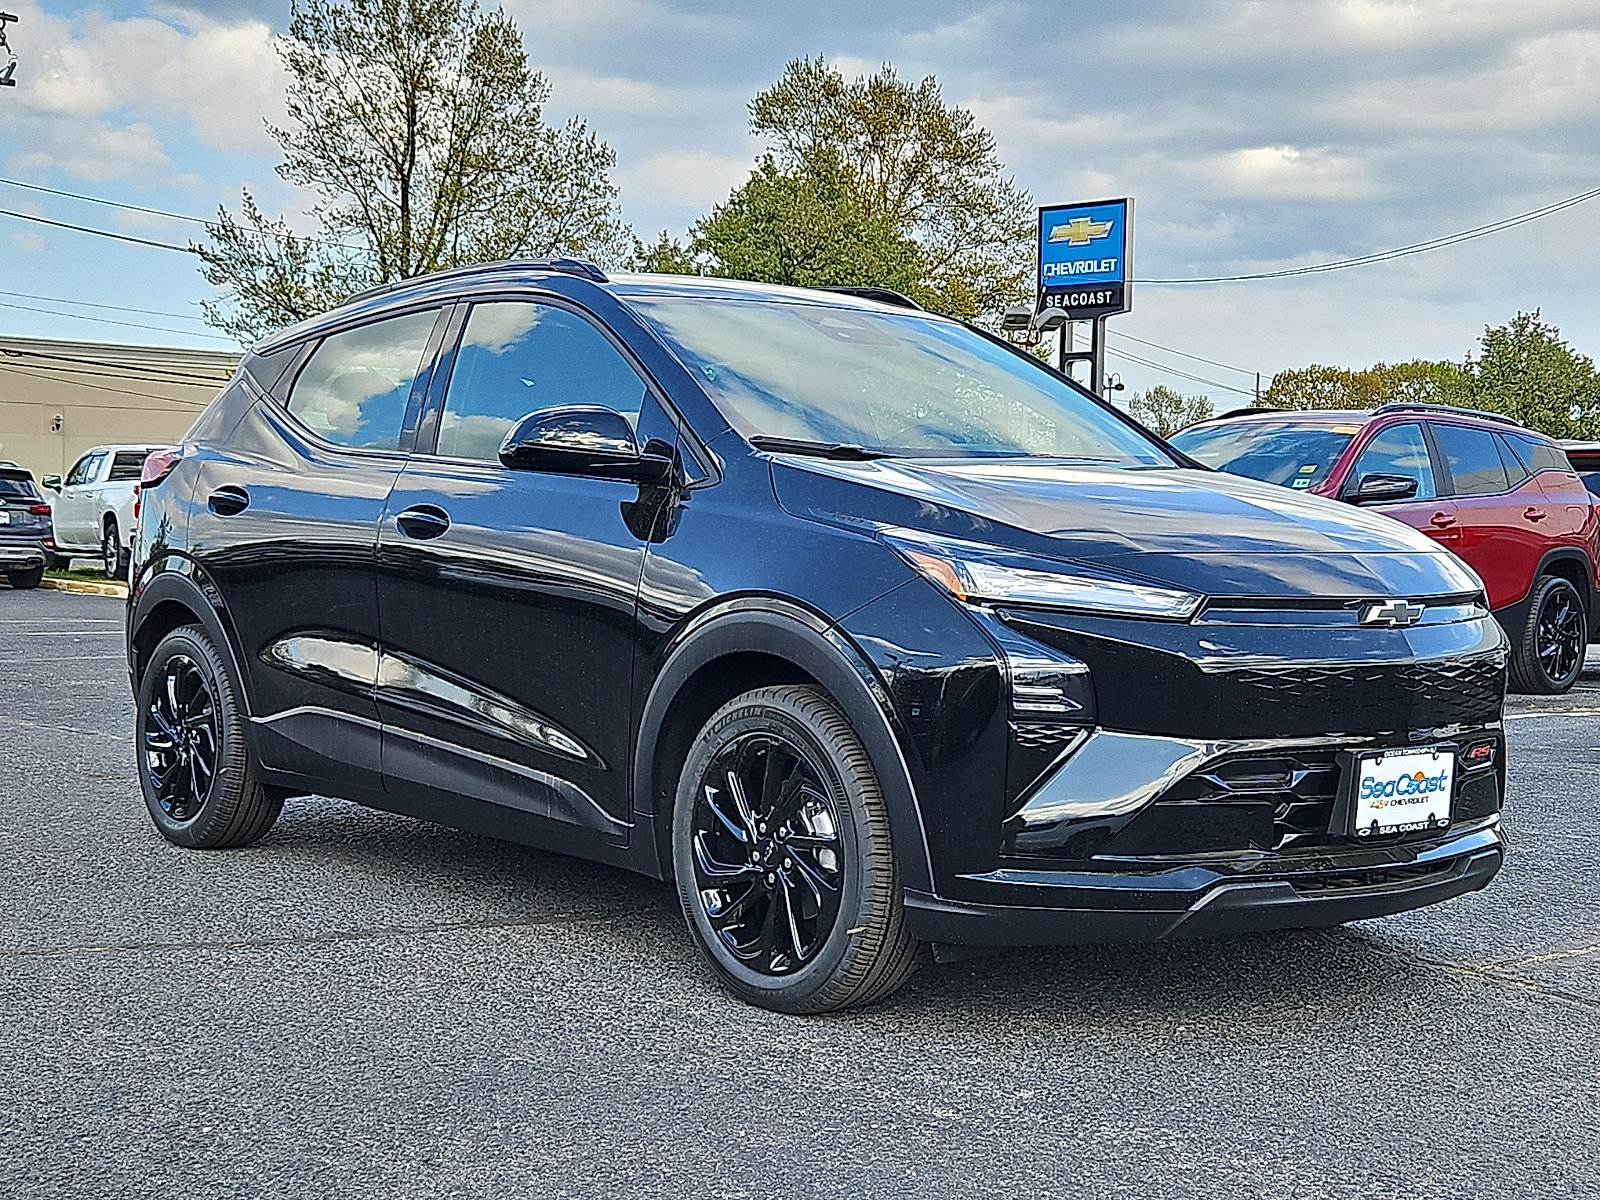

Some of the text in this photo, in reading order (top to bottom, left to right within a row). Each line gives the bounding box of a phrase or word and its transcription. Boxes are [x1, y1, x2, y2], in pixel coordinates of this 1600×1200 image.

[1044, 259, 1117, 276] CHEVROLET
[1046, 291, 1112, 307] SEACOAST
[1470, 745, 1490, 758] RS
[1390, 796, 1429, 806] CHEVROLET
[1379, 821, 1430, 835] SEA COAST
